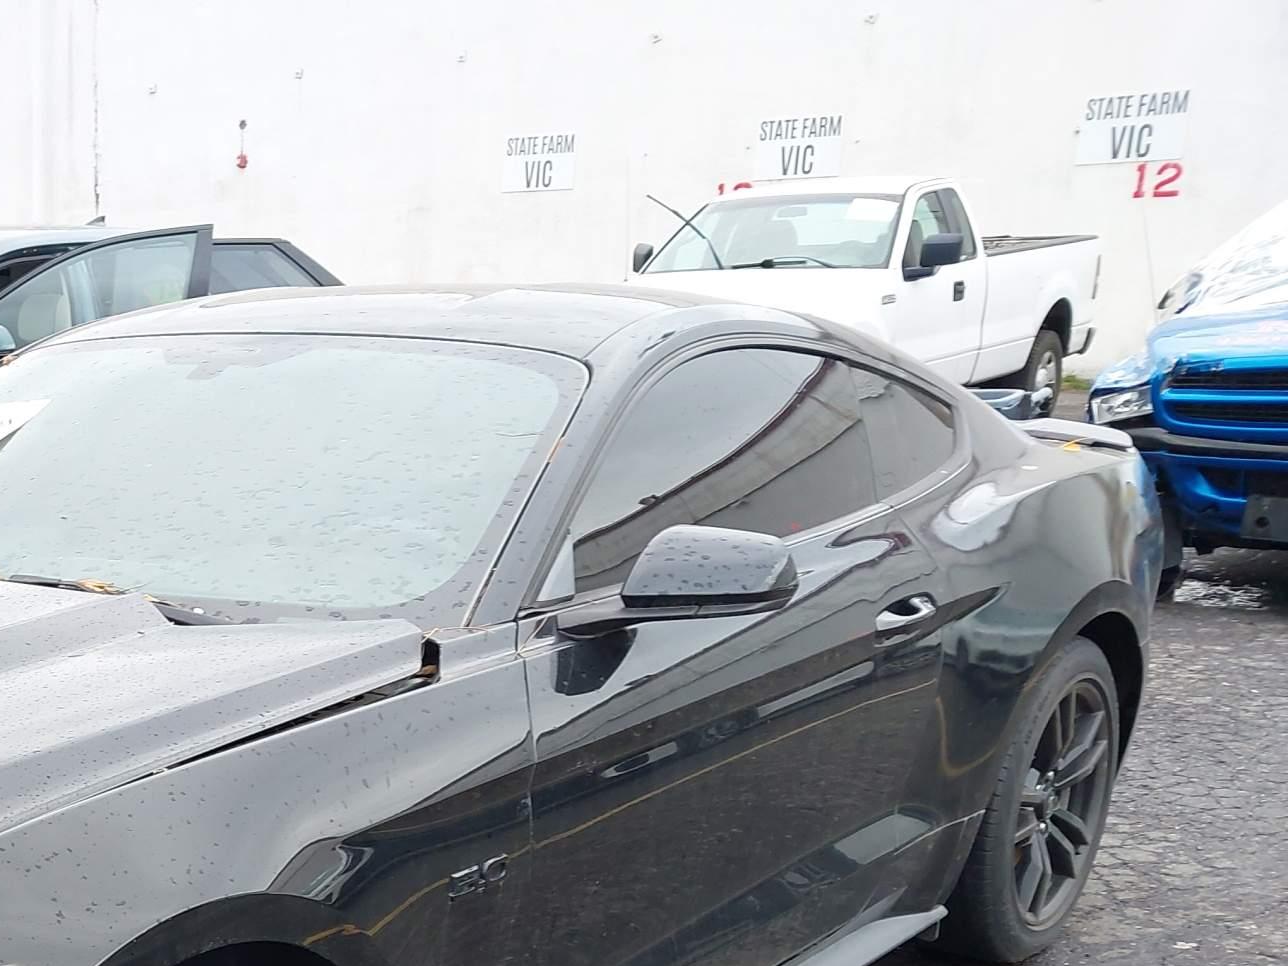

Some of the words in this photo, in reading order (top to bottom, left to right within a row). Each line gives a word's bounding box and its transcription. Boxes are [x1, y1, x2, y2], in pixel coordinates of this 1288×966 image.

[1085, 95, 1135, 121] STATE
[1137, 90, 1190, 118] FARM
[759, 119, 799, 141] STATE
[801, 115, 842, 138] FARM
[1111, 123, 1153, 160] VIC
[506, 136, 539, 157] STATE
[541, 134, 575, 154] FARM
[781, 144, 815, 176] VIC
[525, 160, 553, 188] VIC
[1132, 162, 1183, 199] 12
[448, 853, 509, 902] 5.0
